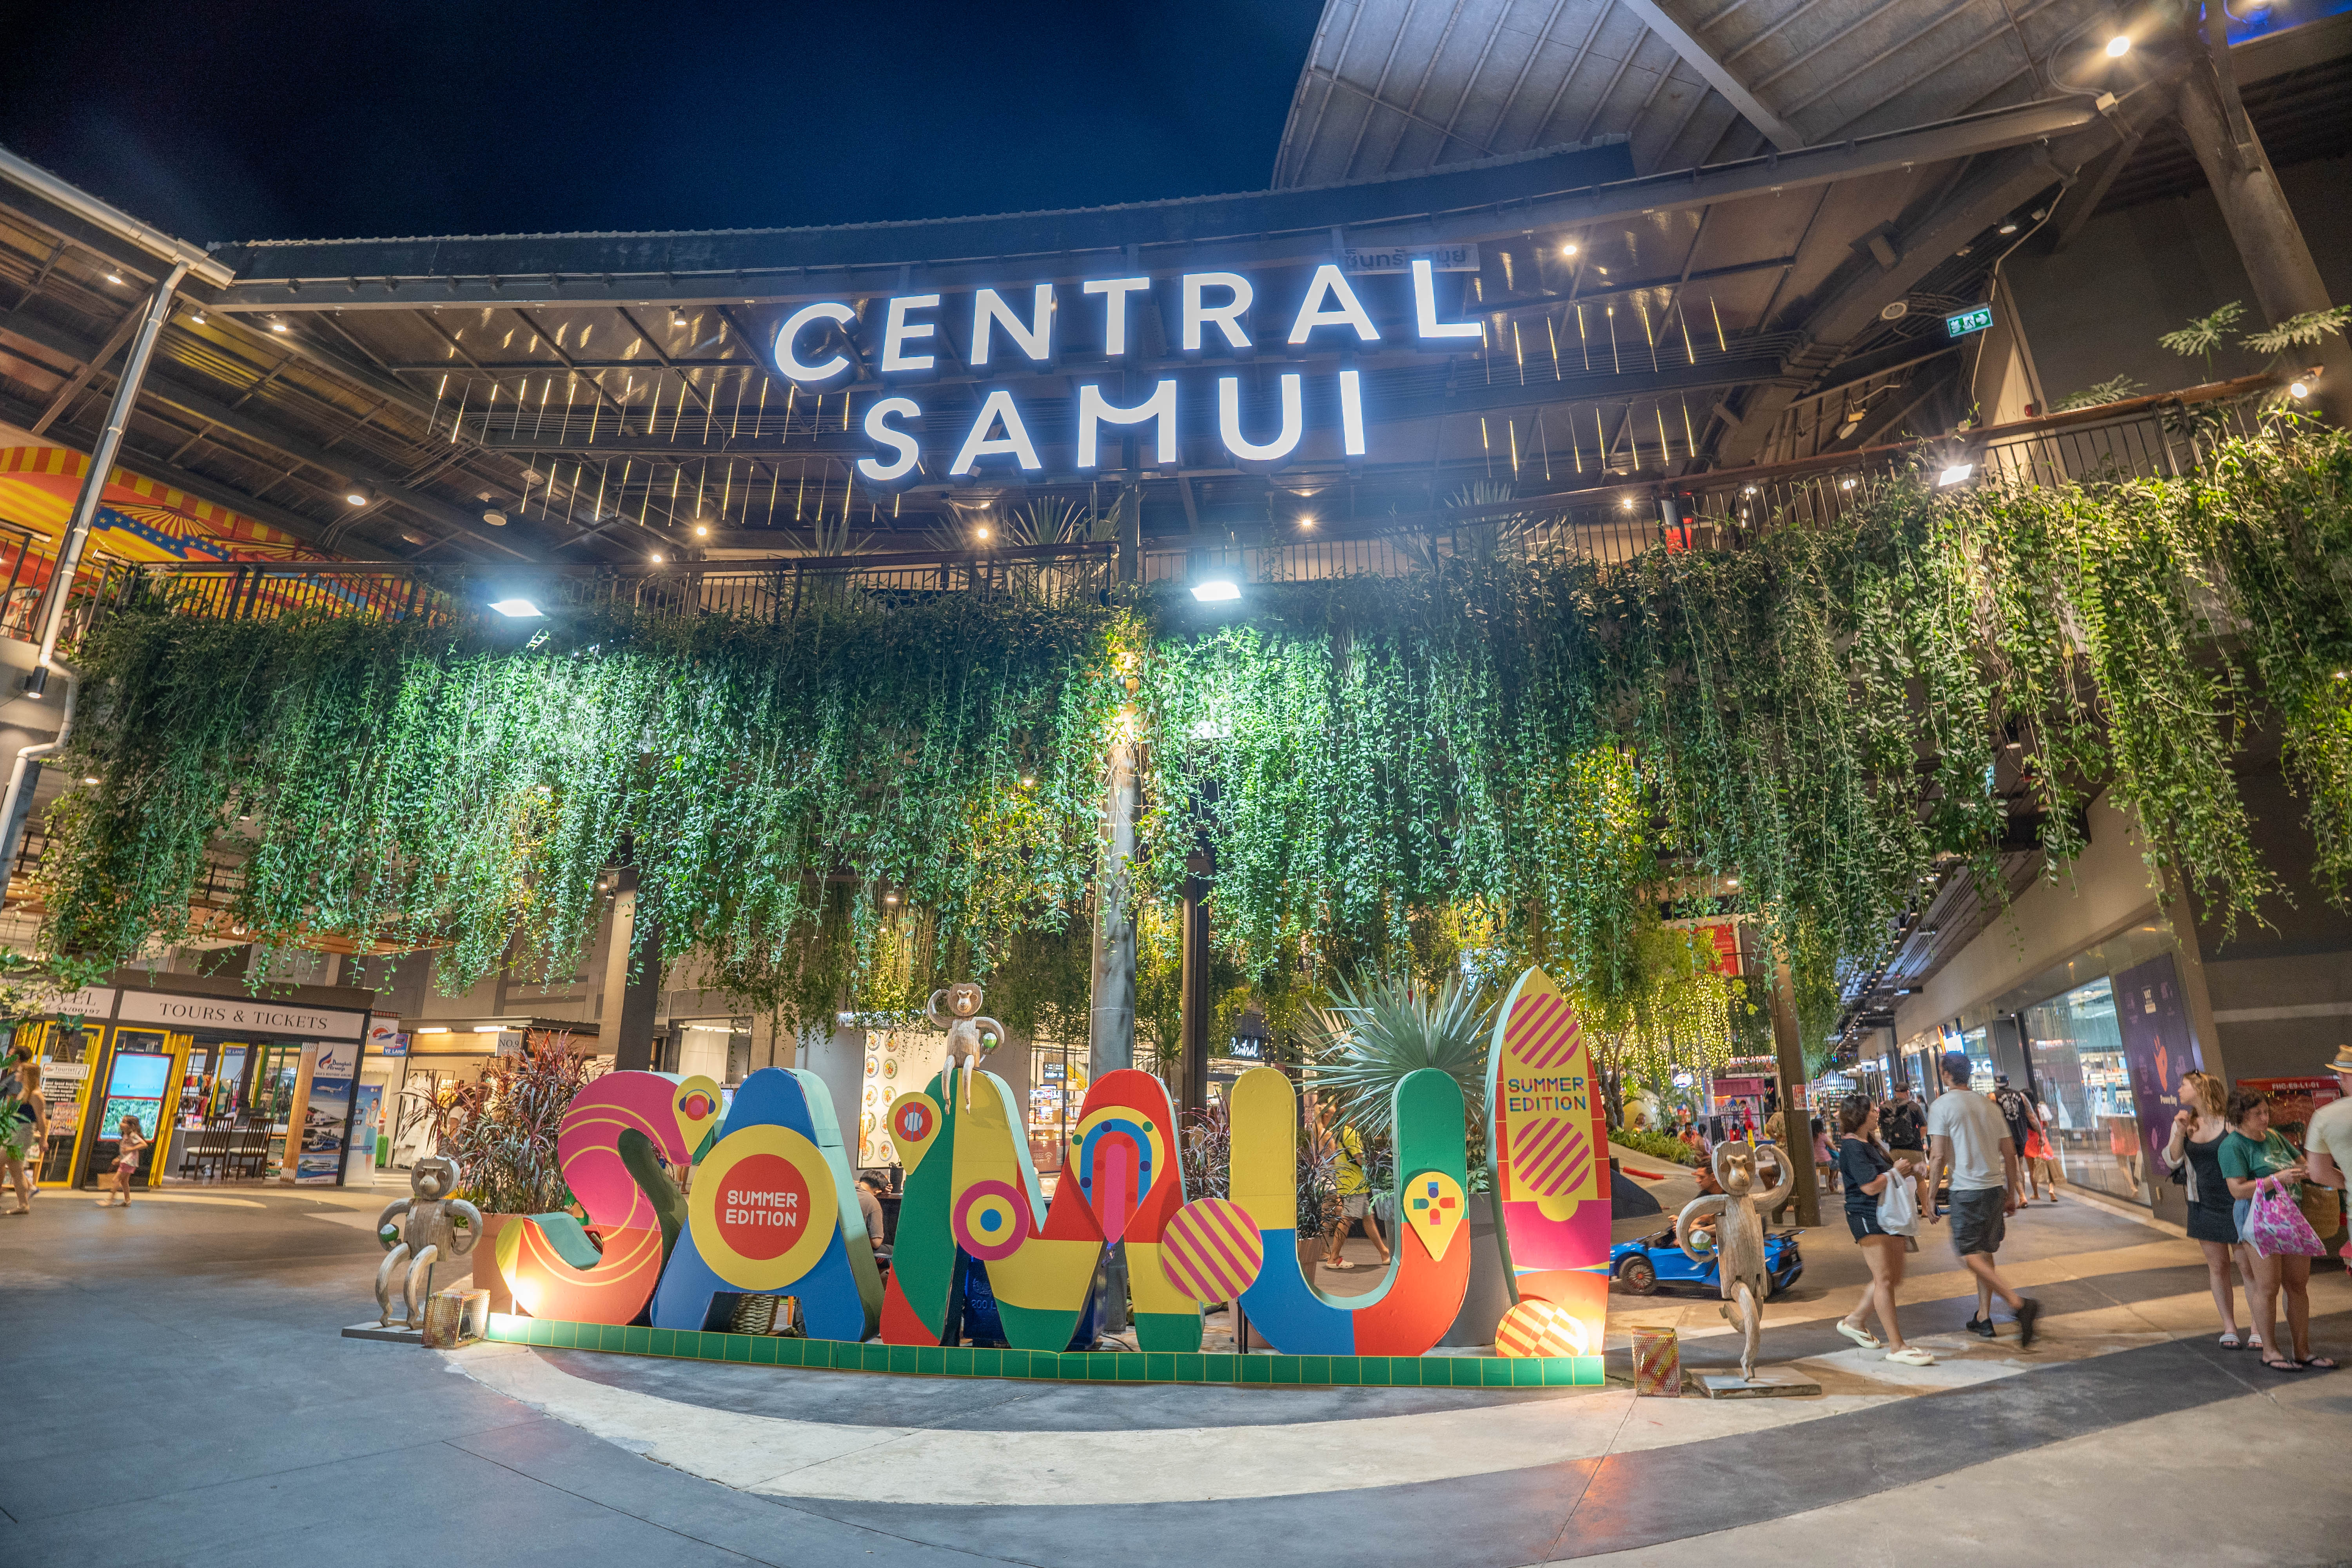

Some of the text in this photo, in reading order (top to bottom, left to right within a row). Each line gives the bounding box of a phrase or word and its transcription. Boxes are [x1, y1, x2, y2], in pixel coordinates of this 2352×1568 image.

[774, 260, 1482, 381] CENTRAL
[857, 370, 1366, 481] SAMUI
[160, 1003, 328, 1030] TOURS & TICKETS
[499, 1039, 519, 1047] NO.9
[327, 1063, 345, 1072] Airways
[1508, 1077, 1584, 1093] SUMMER
[1510, 1096, 1586, 1112] EDITION
[728, 1190, 798, 1207] SUMMER
[726, 1209, 797, 1227] EDITION
[971, 1299, 996, 1309] 200 L
